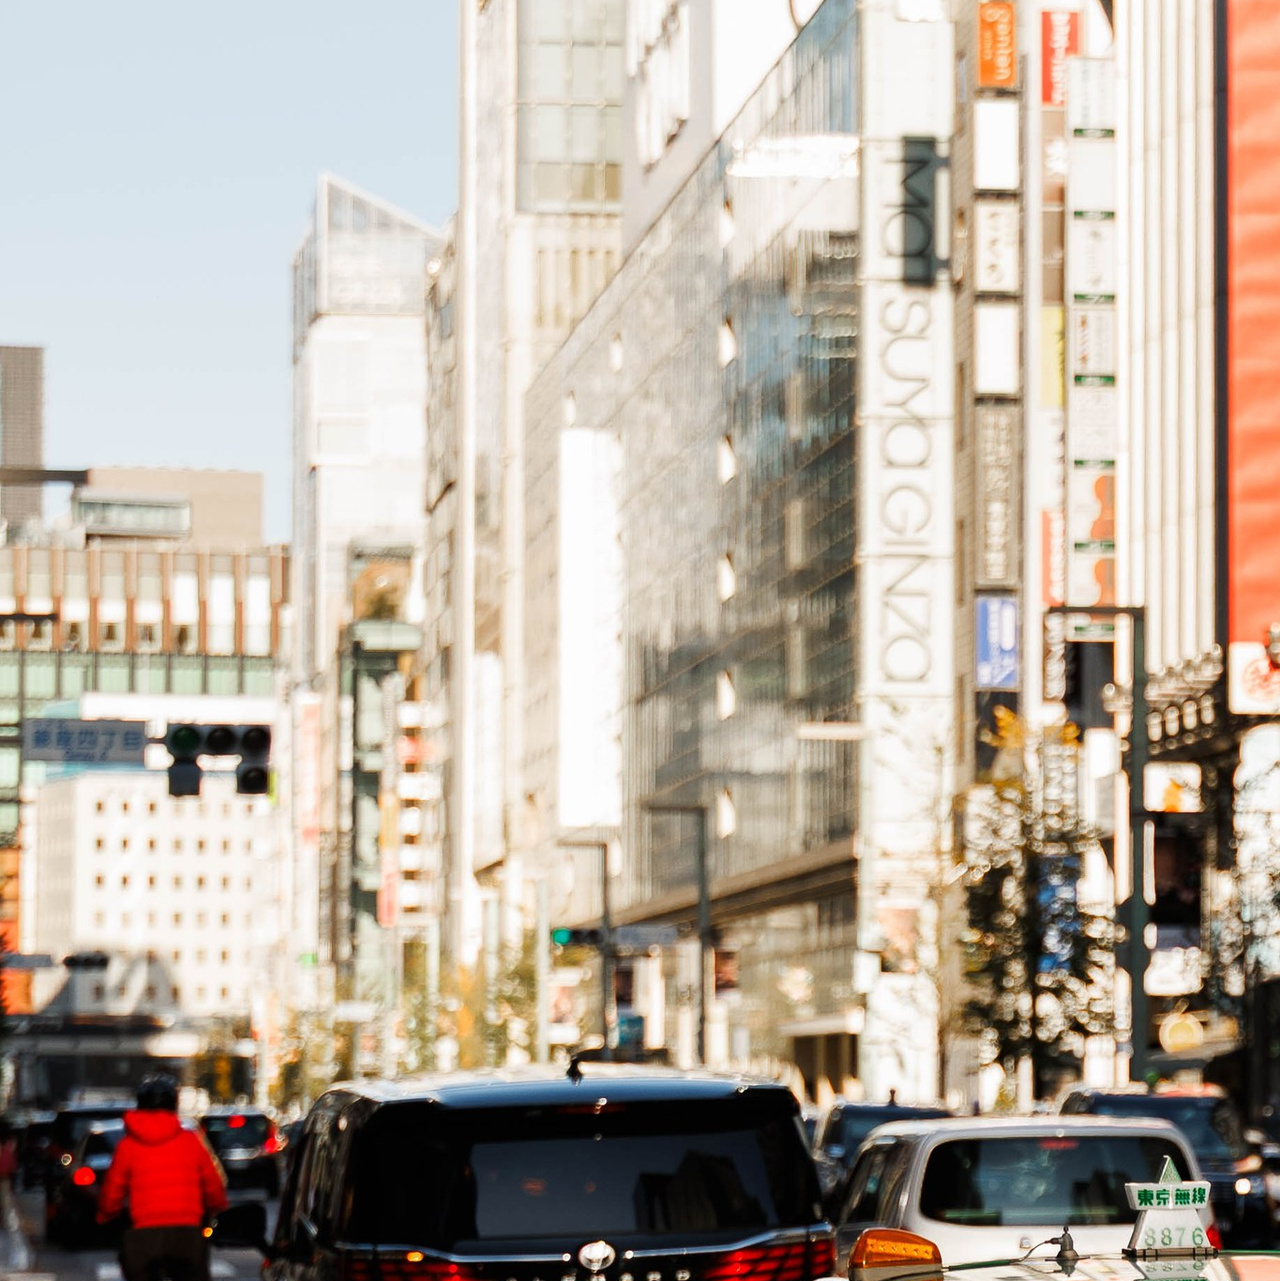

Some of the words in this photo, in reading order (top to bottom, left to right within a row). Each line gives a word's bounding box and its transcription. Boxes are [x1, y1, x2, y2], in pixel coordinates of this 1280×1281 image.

[1137, 1187, 1206, 1207] 東京無線
[1144, 1227, 1204, 1247] 8876
